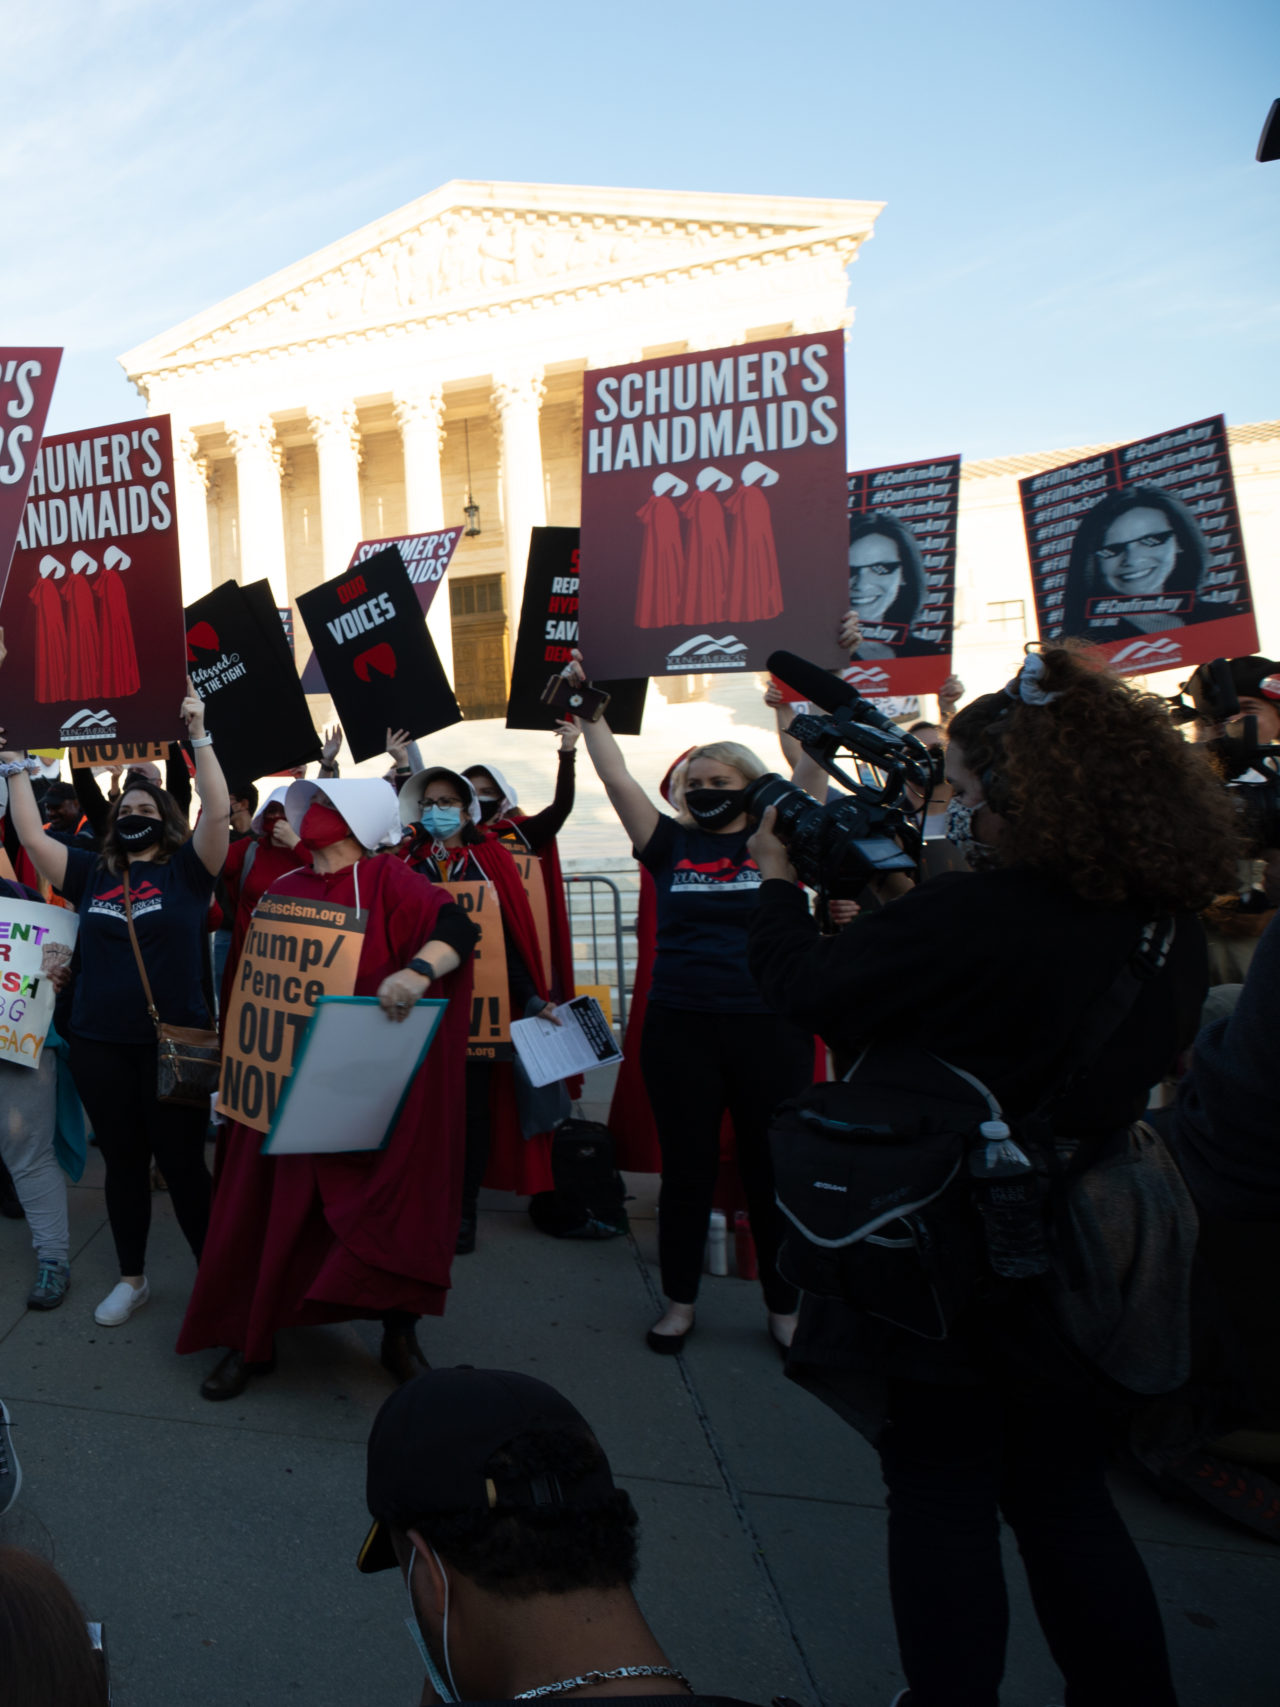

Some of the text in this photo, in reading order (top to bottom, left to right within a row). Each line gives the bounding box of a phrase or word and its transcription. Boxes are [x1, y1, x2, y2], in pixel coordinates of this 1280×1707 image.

[594, 343, 829, 423] SCHUMER'S
[588, 395, 839, 474] HANDMAIDS
[1124, 424, 1215, 462] #ConfirmAmy
[28, 427, 163, 497] HUMER'S
[871, 463, 953, 488] #ConfirmAmy
[1031, 456, 1105, 492] #FillTheSeat
[1126, 442, 1217, 479] #ConfirmAmy
[871, 482, 952, 505] #ConfirmAmy
[1033, 474, 1108, 508] #FillTheSeat
[17, 481, 171, 550] ANDMAIDS
[336, 575, 368, 605] OUR
[1094, 597, 1184, 614] #ConfirmAmy
[326, 592, 397, 645] VOICES
[545, 619, 579, 641] SAV
[204, 677, 223, 694] THE
[220, 662, 247, 684] FIGHT
[245, 922, 345, 972] Trump/
[240, 960, 325, 1008] Pence
[238, 1002, 317, 1063] OUT
